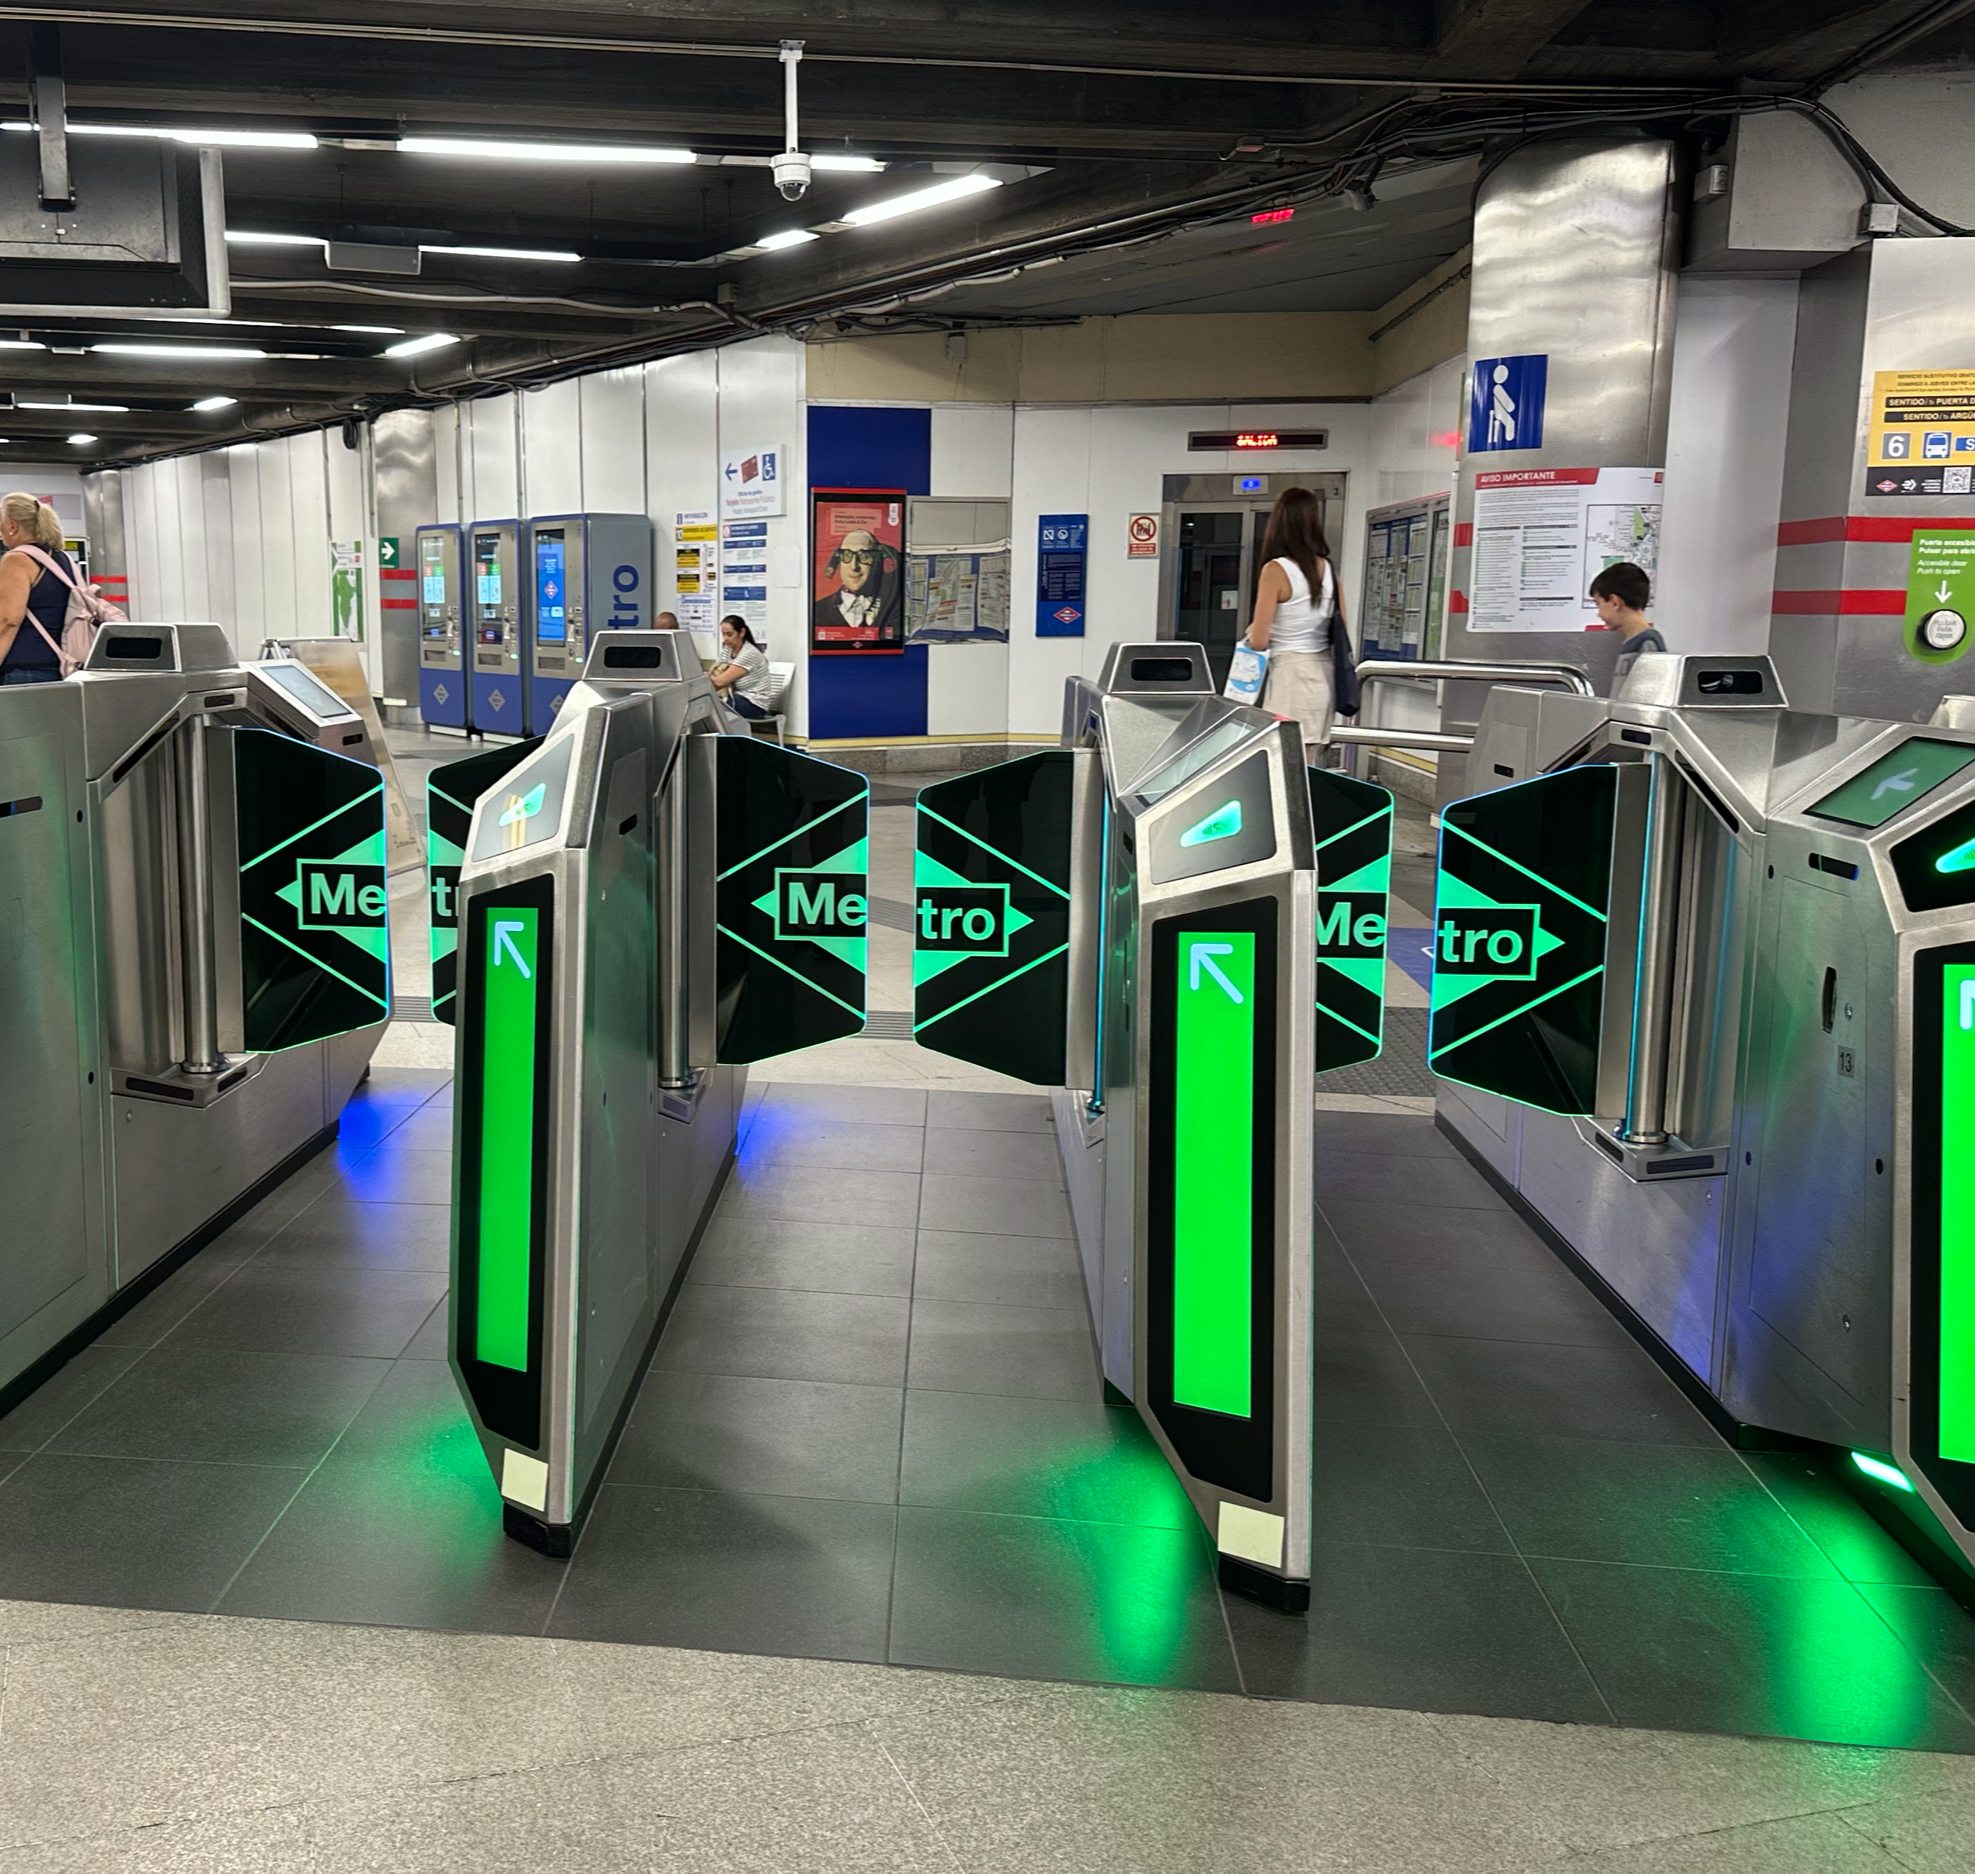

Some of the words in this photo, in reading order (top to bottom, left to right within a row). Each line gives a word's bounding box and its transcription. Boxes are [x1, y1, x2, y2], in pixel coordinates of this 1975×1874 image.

[1236, 434, 1278, 446] SALIDA
[1888, 435, 1905, 457] 6
[1333, 487, 1339, 496] 3
[1481, 474, 1501, 483] AVISO
[1502, 471, 1556, 482] IMPORTANTE
[310, 872, 387, 916] Me
[787, 882, 868, 927] Me
[917, 898, 996, 941] tro
[1316, 902, 1386, 947] Me
[1438, 920, 1524, 964] tro
[1839, 1052, 1853, 1073] 13
